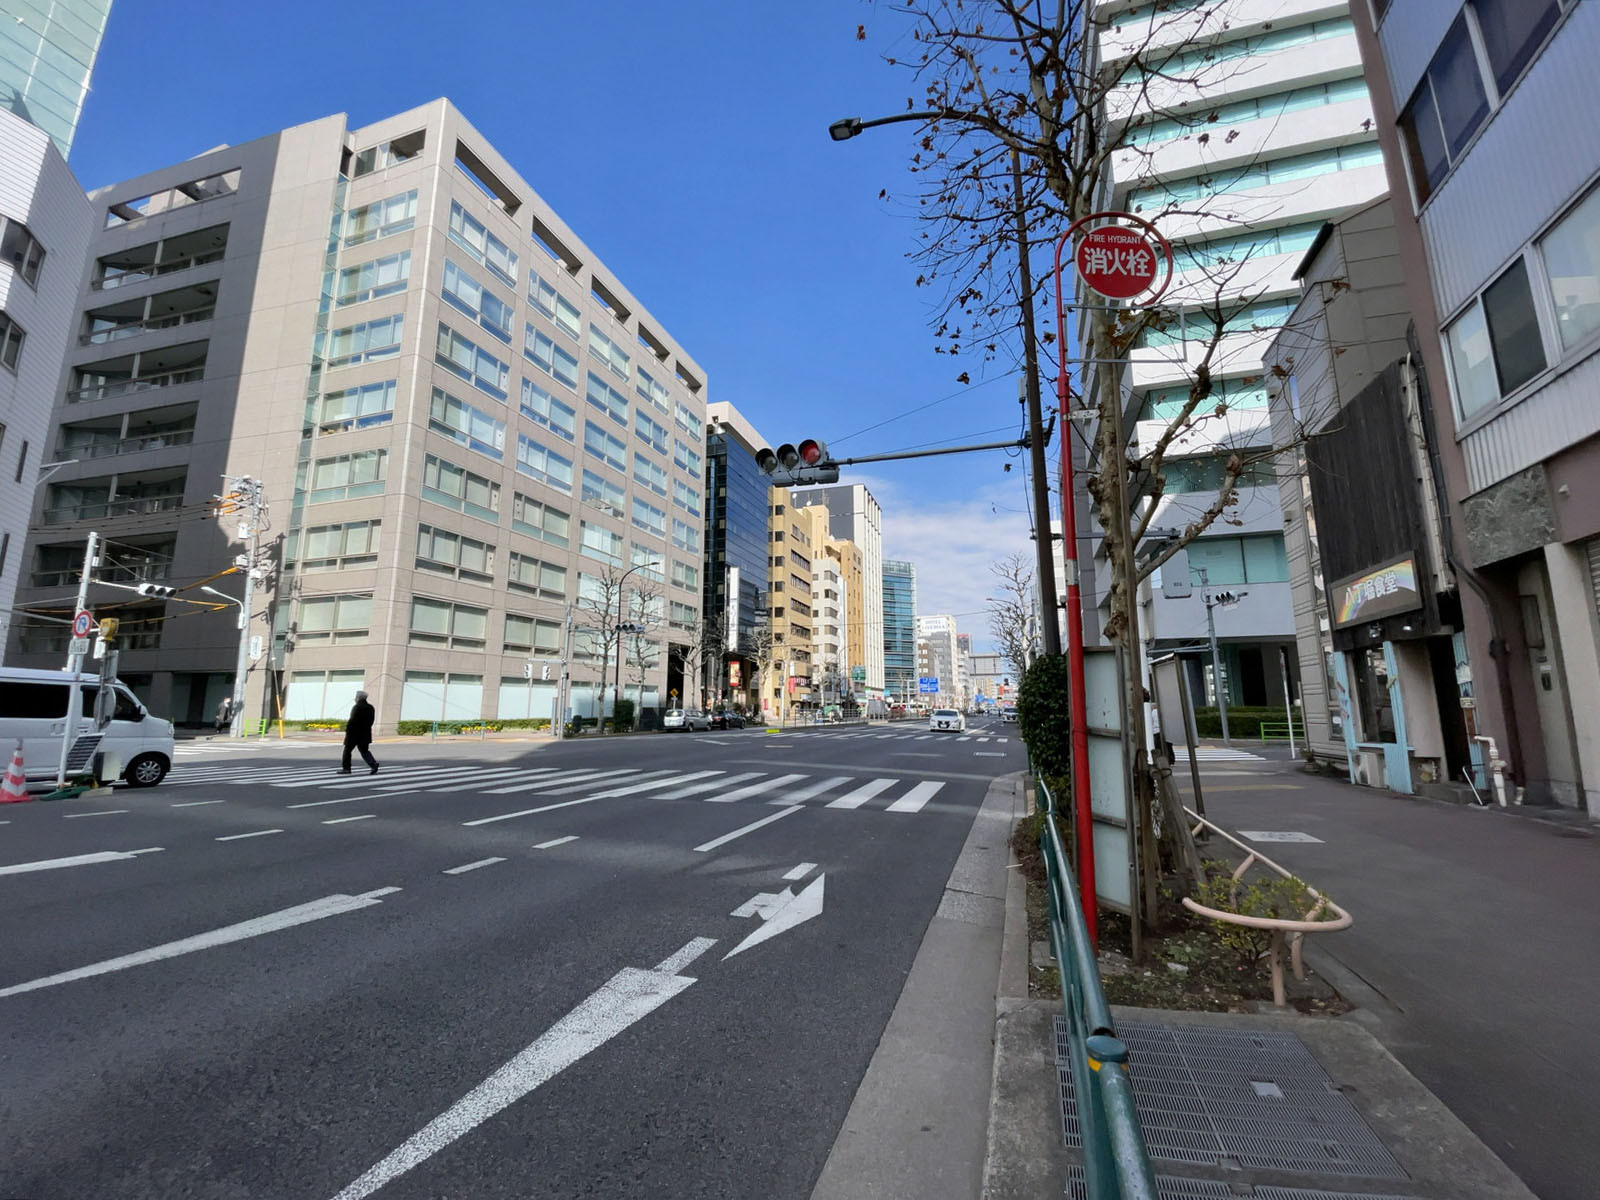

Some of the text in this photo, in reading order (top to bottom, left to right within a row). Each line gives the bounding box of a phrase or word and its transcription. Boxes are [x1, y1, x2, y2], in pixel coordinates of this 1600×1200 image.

[1089, 234, 1141, 244] FIRE HYDRANT
[1084, 247, 1150, 276] 消火栓
